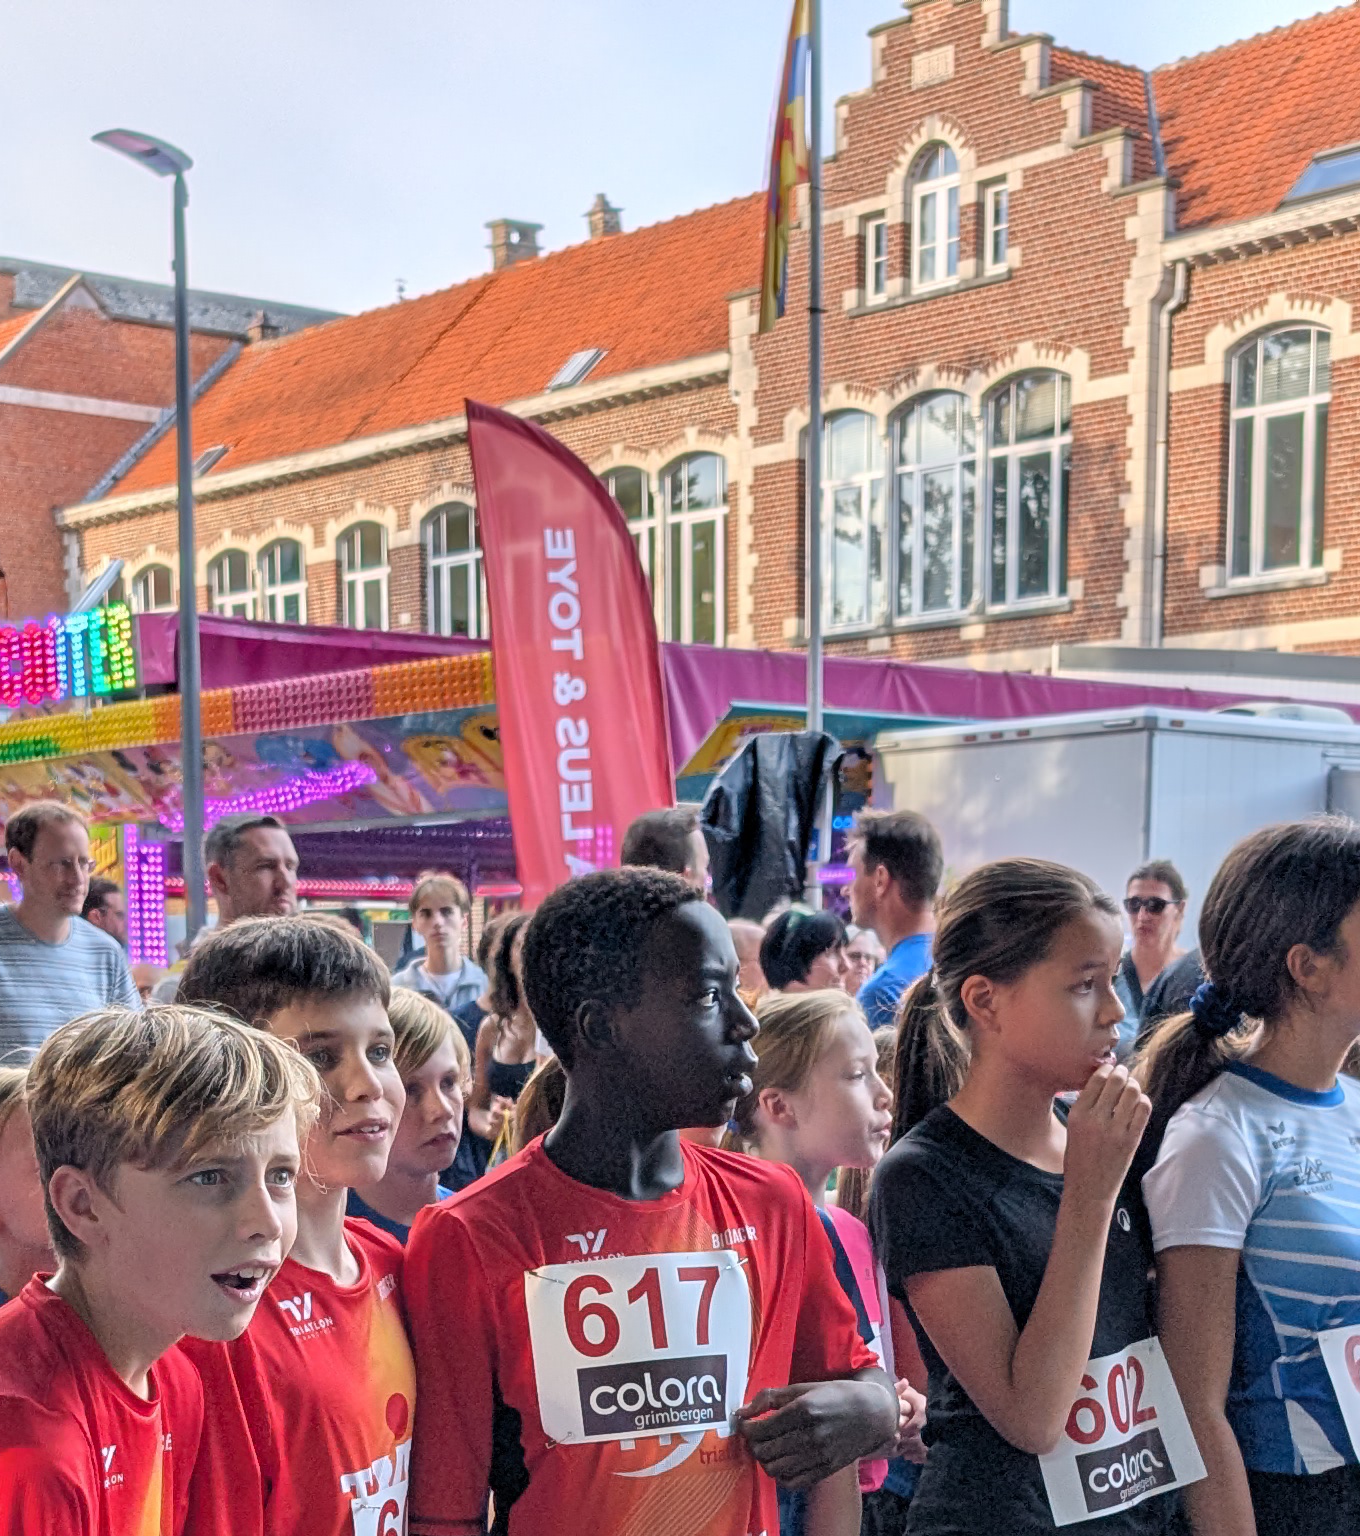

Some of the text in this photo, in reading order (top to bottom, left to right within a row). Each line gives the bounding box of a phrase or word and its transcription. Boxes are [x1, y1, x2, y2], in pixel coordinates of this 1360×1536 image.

[563, 1266, 721, 1358] 617
[590, 1372, 722, 1416] colora
[1065, 1356, 1158, 1445] 602
[634, 1406, 715, 1431] grimbergen
[1089, 1448, 1164, 1494] colora
